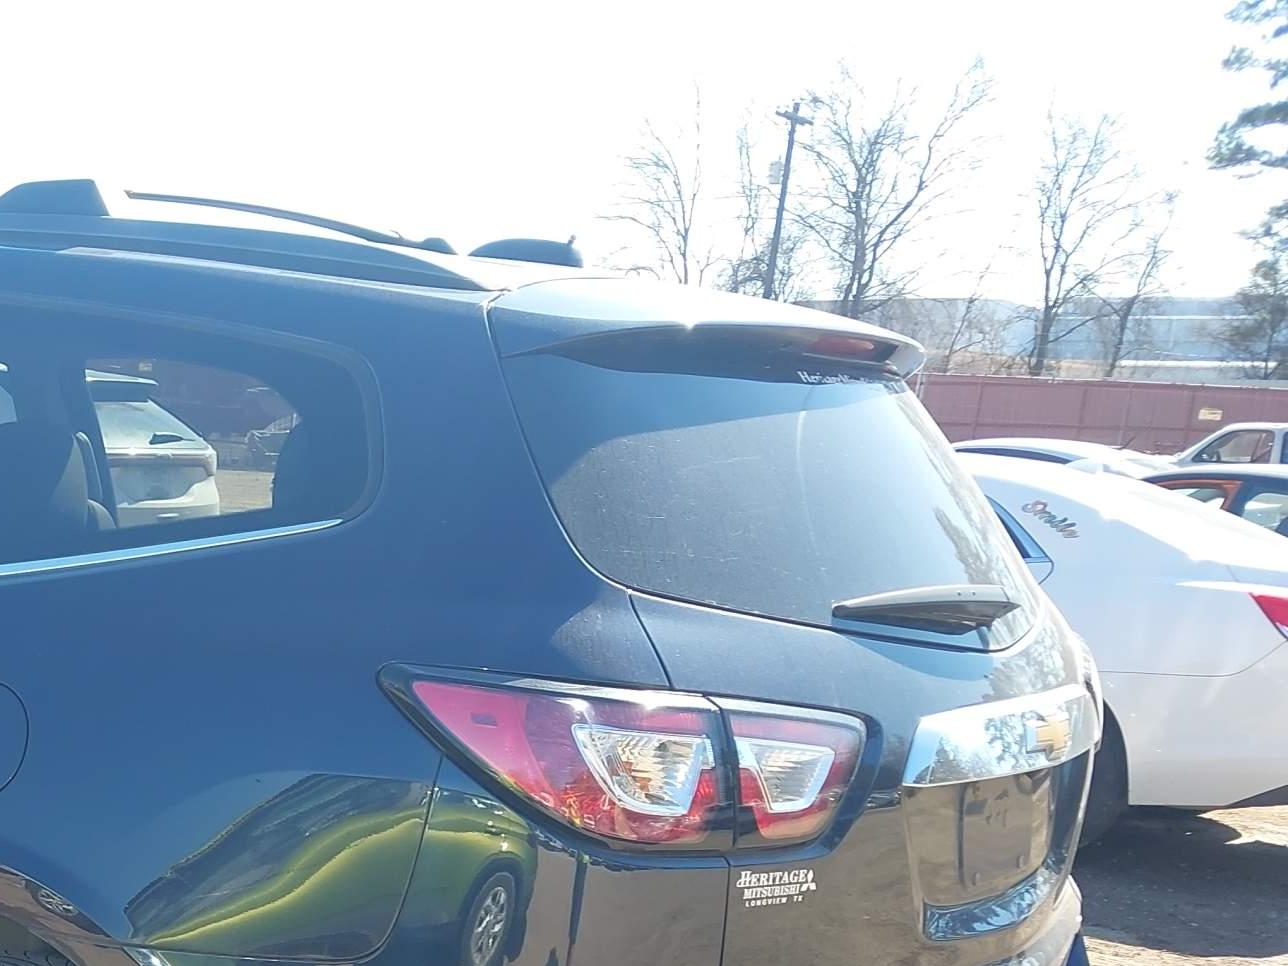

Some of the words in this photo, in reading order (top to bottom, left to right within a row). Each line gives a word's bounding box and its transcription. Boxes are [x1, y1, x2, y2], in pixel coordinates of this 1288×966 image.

[736, 869, 808, 888] HERITAGE
[743, 884, 801, 899] MITSUBISHI
[745, 897, 788, 907] LONGVIEW
